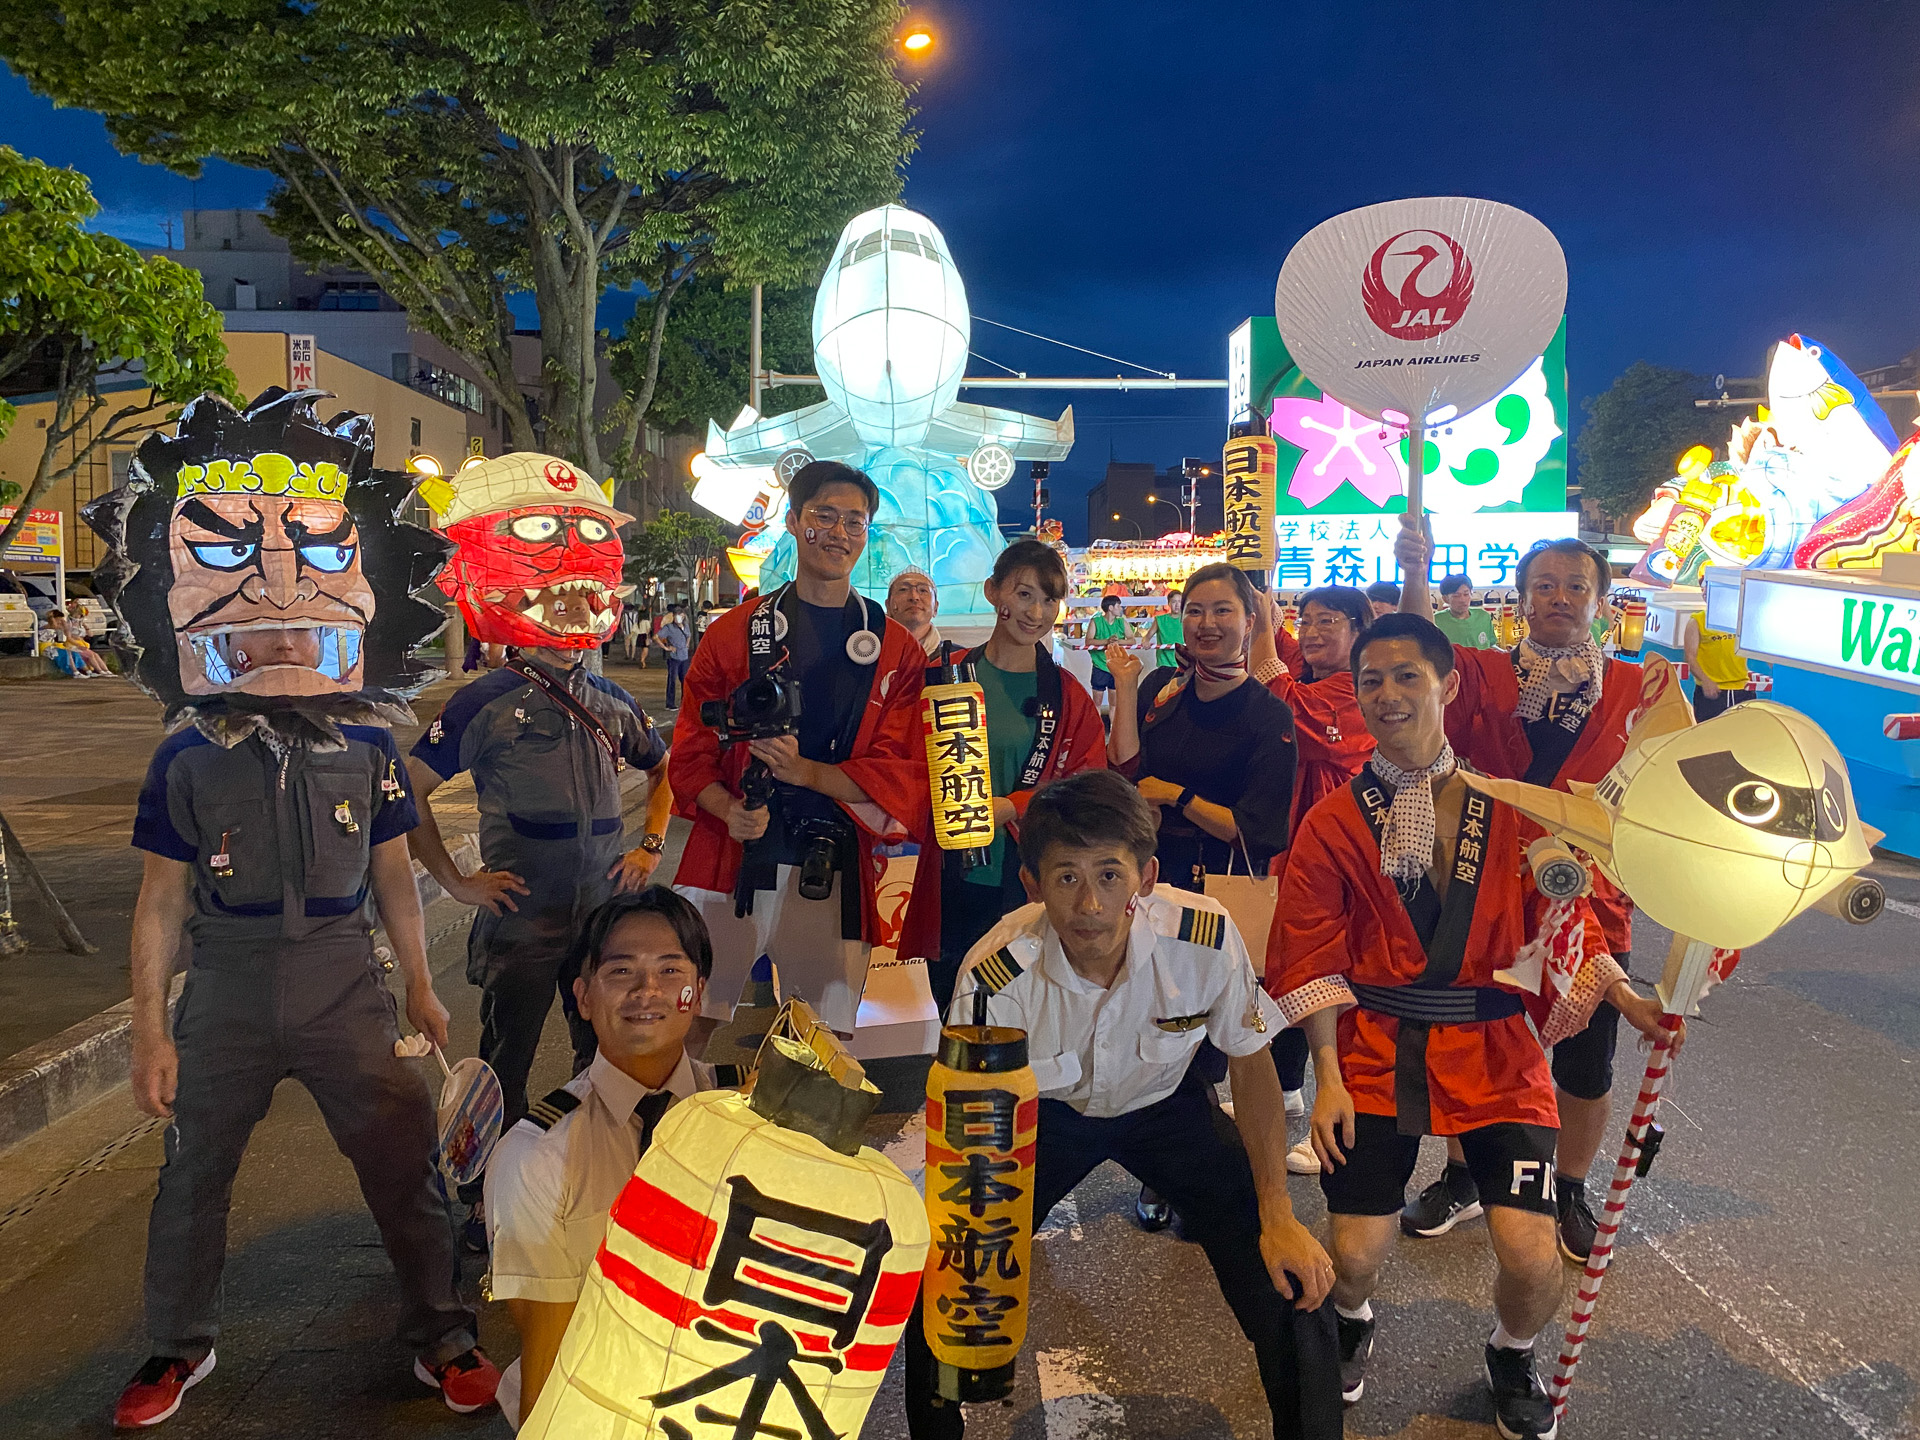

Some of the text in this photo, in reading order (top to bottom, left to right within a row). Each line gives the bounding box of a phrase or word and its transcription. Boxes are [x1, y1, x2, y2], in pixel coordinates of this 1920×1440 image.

[1391, 308, 1452, 328] JAL
[1354, 354, 1481, 369] JAPAN AIRLINES
[1225, 446, 1262, 560] 日本航空
[1280, 520, 1390, 541] 学校法人
[523, 666, 551, 688] Canon
[596, 728, 613, 753] Canon
[1021, 720, 1056, 785] 日本航空
[932, 696, 991, 838] 日本航空
[1454, 796, 1486, 885] 日本航空
[869, 961, 897, 969] APAN
[936, 1089, 1023, 1348] 日本航空
[638, 1175, 894, 1440] 日本
